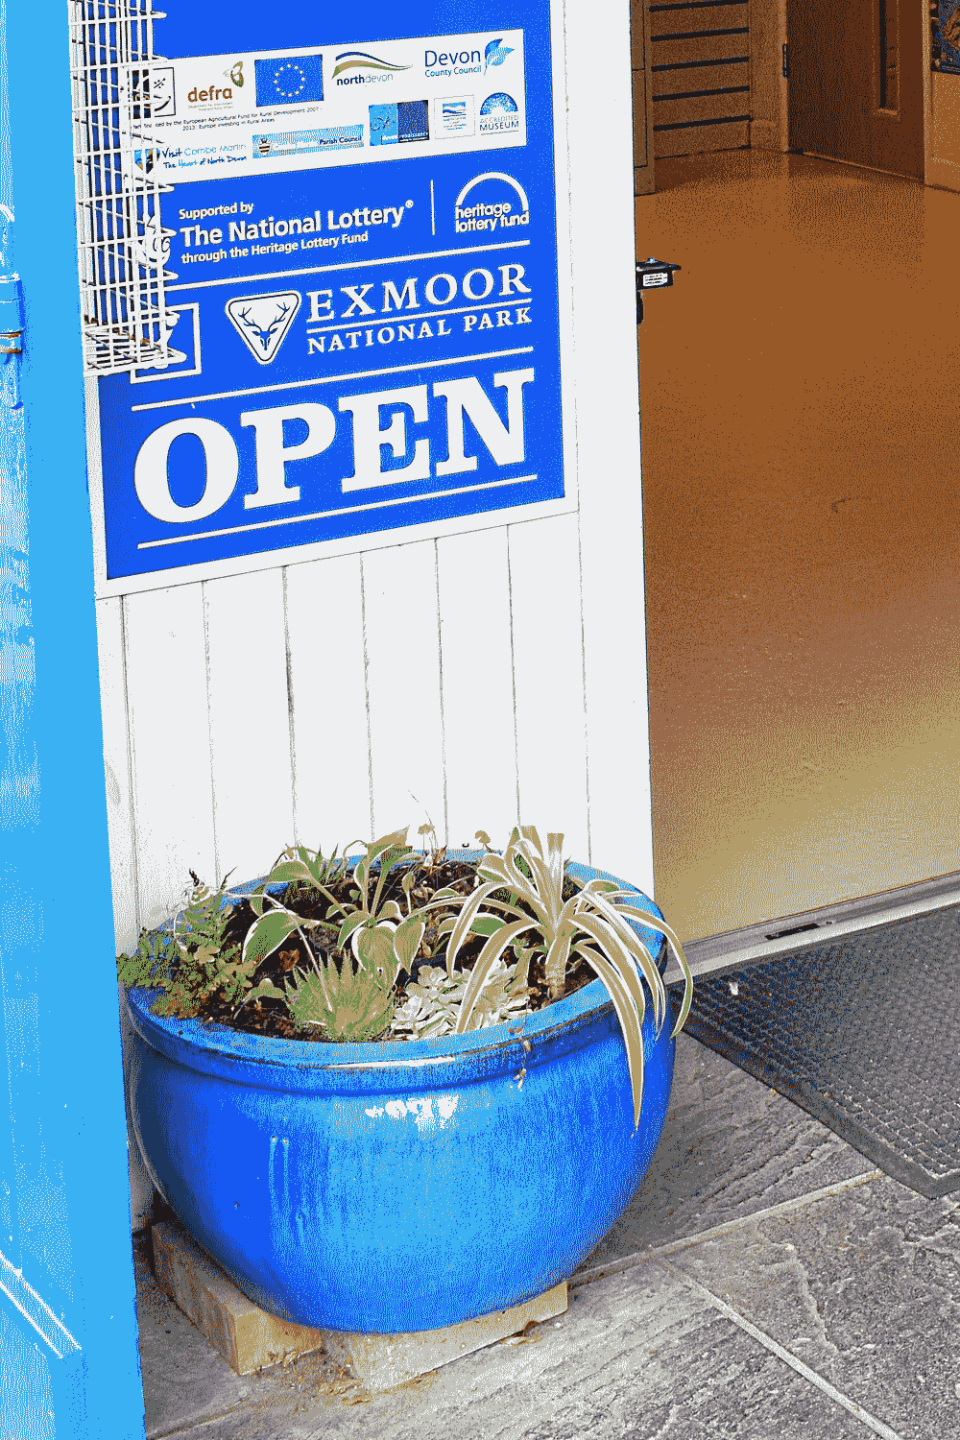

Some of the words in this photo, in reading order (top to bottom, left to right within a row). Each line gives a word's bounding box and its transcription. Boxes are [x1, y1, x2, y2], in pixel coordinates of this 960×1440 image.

[425, 50, 481, 67] Devon
[337, 73, 393, 86] northdevon
[454, 66, 481, 74] Council
[188, 86, 233, 103] defra
[480, 121, 519, 131] MUSEUM
[178, 202, 237, 219] Supported
[241, 201, 253, 215] by
[455, 202, 511, 222] heritage
[180, 226, 223, 248] The
[229, 215, 320, 243] National
[455, 218, 497, 233] lottery
[500, 212, 529, 230] fund
[181, 251, 227, 264] through
[230, 247, 248, 259] the
[251, 240, 298, 258] Heritage
[301, 235, 338, 252] Lottery
[342, 231, 368, 244] Fund
[307, 264, 532, 323] EXMOOR
[307, 320, 451, 355] NATIONAL
[463, 306, 533, 333] PARK
[134, 368, 534, 523] OPEN
